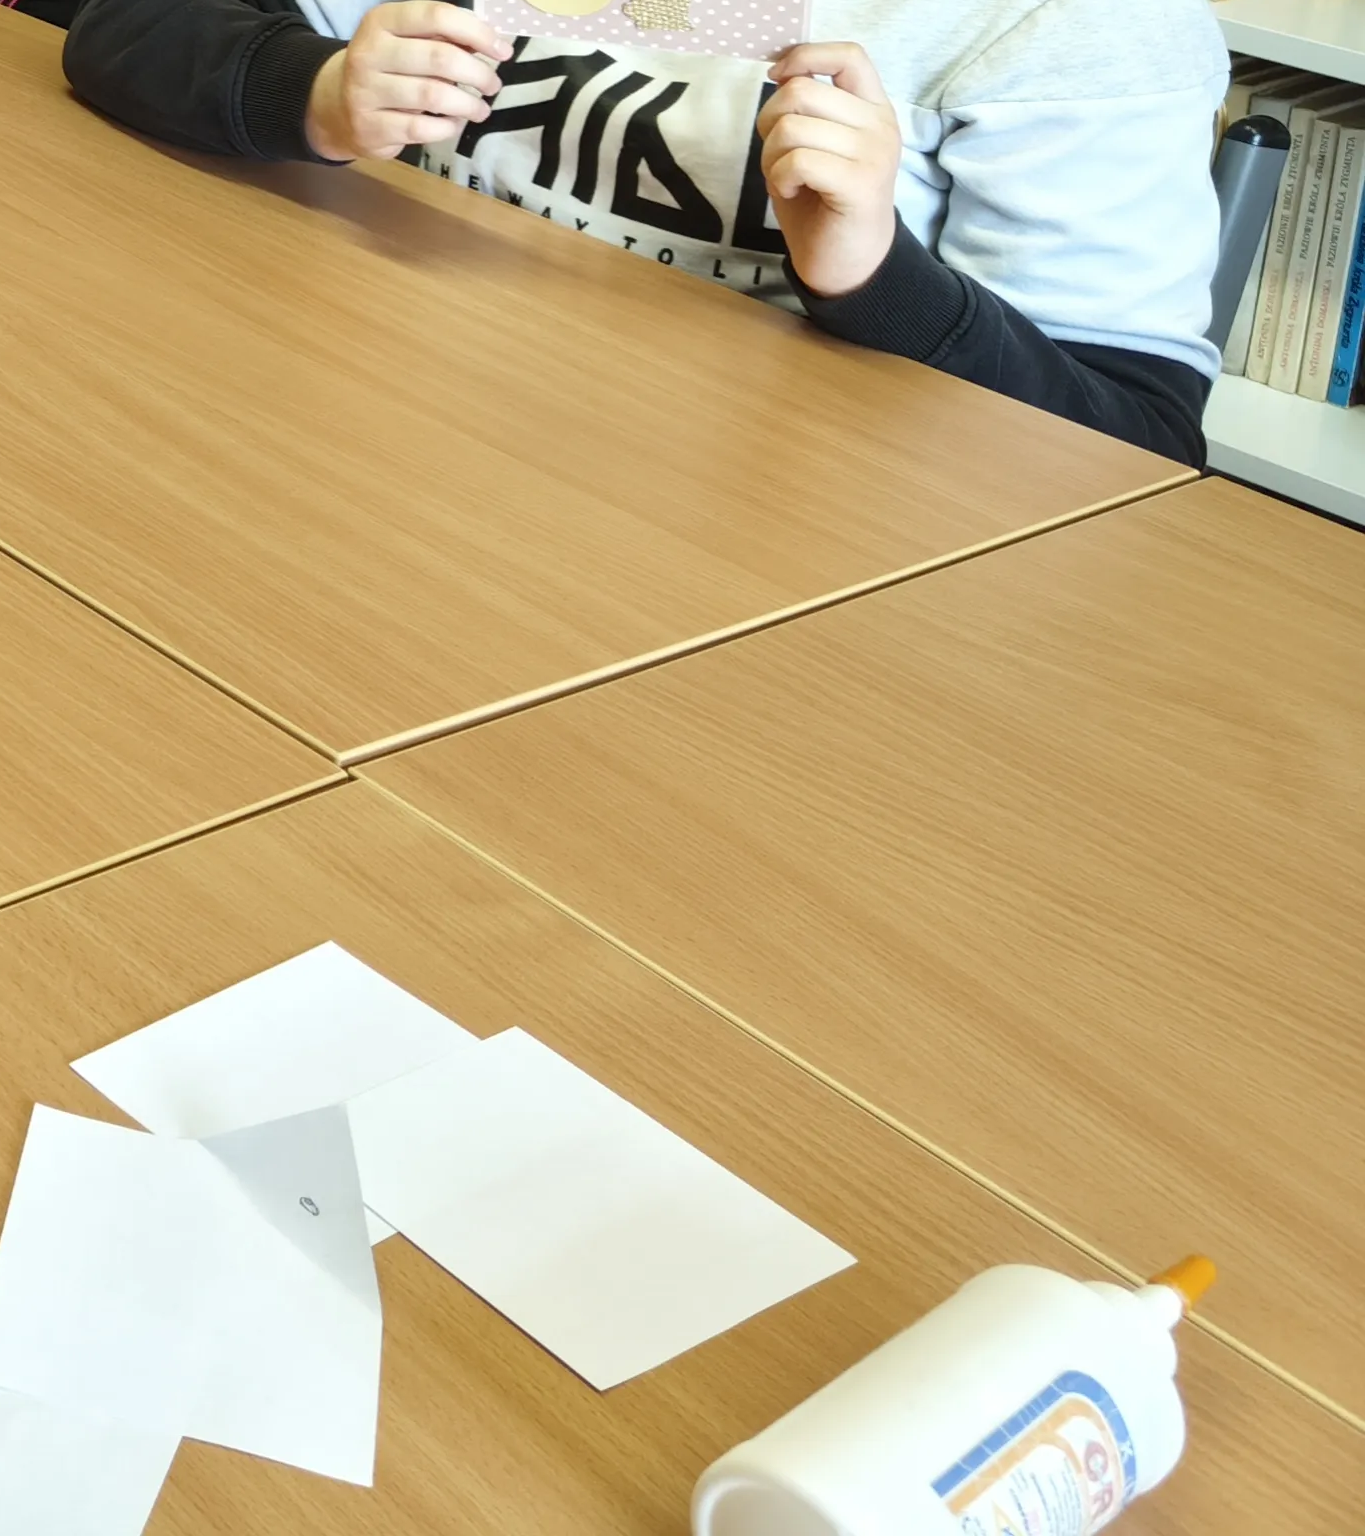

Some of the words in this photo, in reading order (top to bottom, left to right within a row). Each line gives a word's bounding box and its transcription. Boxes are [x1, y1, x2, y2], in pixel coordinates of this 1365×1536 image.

[1340, 136, 1357, 188] ZYGMUNTA
[1299, 216, 1315, 260] PAZIOWIE
[1307, 182, 1320, 214] KRÓLA
[1315, 128, 1331, 181] ZYGMUNTA
[1337, 190, 1347, 222] KRÓLA
[508, 189, 589, 232] WAY
[622, 235, 673, 266] TO
[1329, 222, 1342, 268] PAZIOWIE
[1341, 296, 1358, 350] Zygmunta
